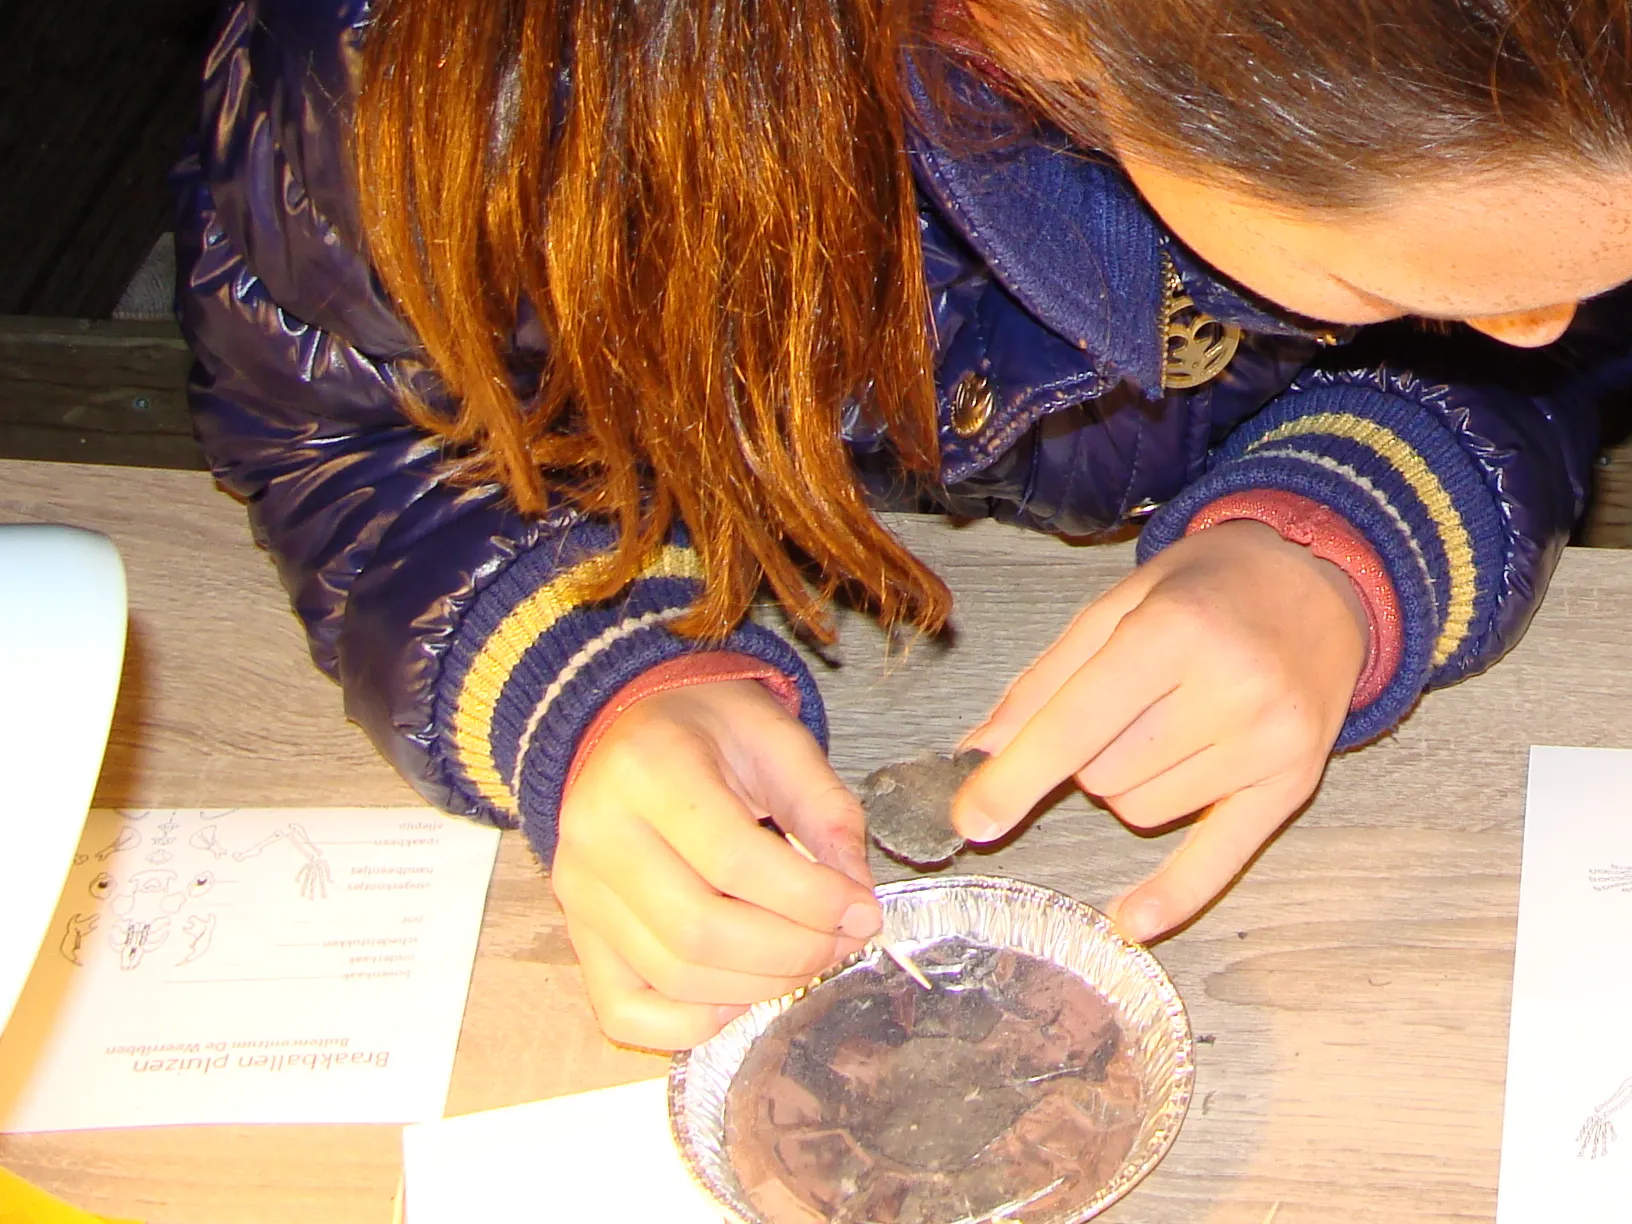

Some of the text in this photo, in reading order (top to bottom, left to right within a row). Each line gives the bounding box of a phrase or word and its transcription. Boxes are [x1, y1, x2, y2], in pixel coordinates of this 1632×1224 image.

[104, 1037, 349, 1056] Buitencentrum De Weerribben
[133, 1051, 390, 1075] Braakballen pluizen
